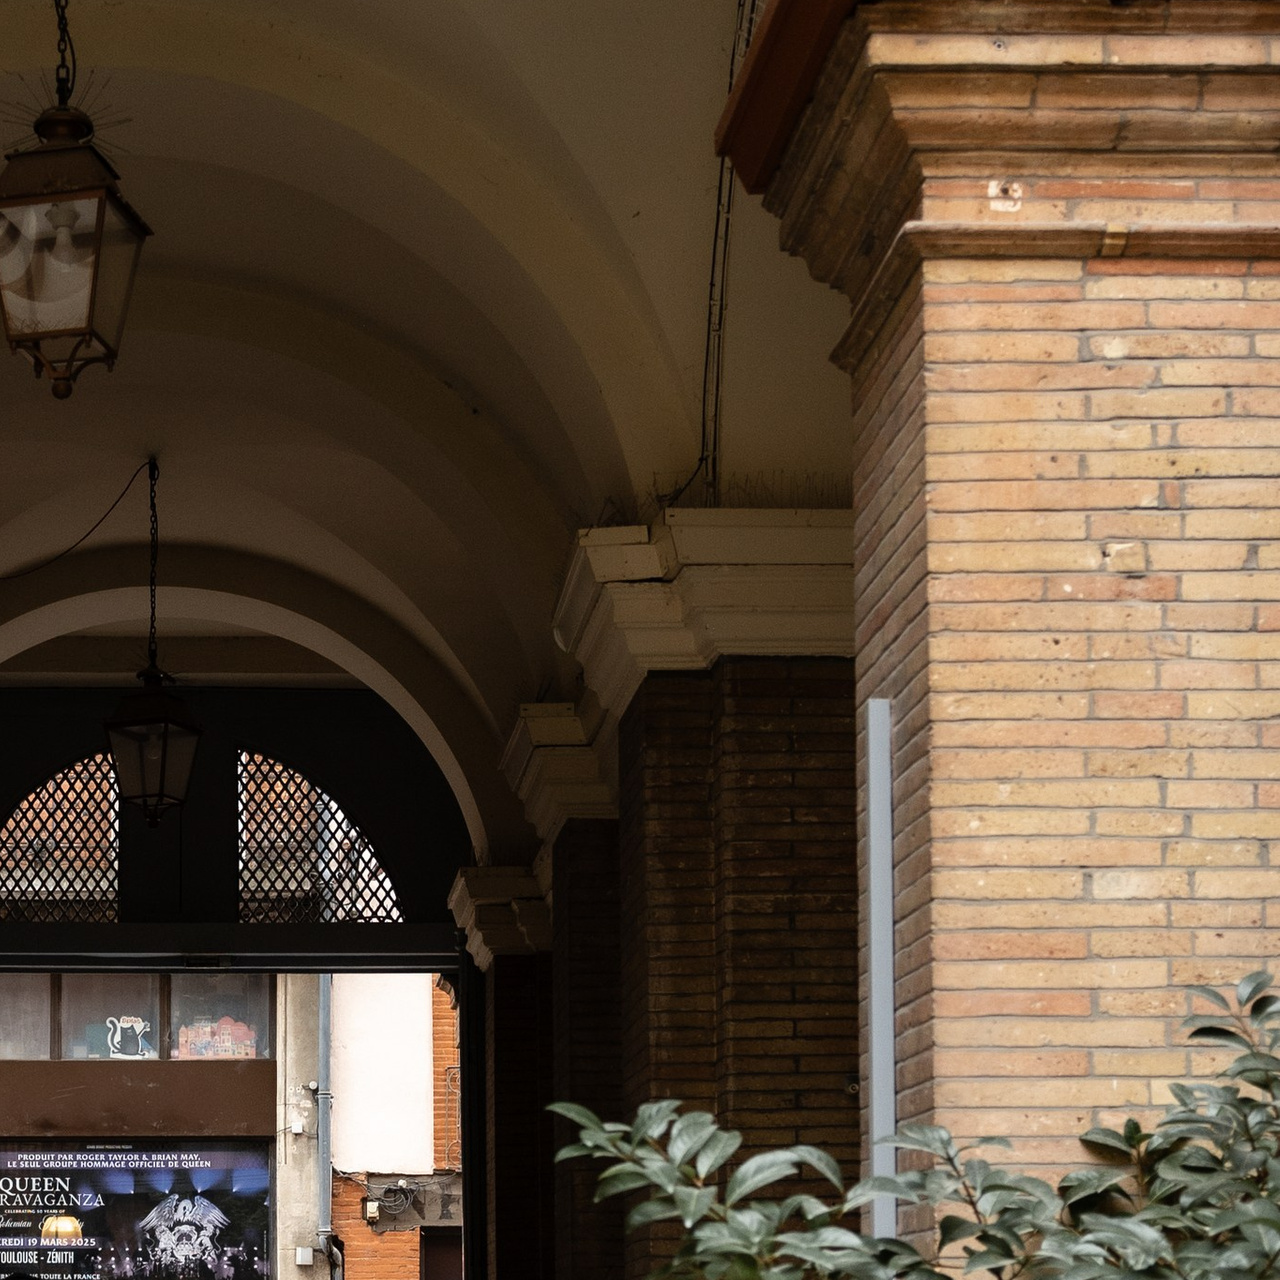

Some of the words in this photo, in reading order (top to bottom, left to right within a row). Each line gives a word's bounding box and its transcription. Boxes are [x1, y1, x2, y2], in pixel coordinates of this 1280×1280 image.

[183, 1161, 211, 1169] QUEEN
[27, 1238, 38, 1247] 19
[40, 1238, 68, 1247] MARS
[70, 1238, 96, 1247] 2025
[46, 1249, 75, 1264] ZÉNITH
